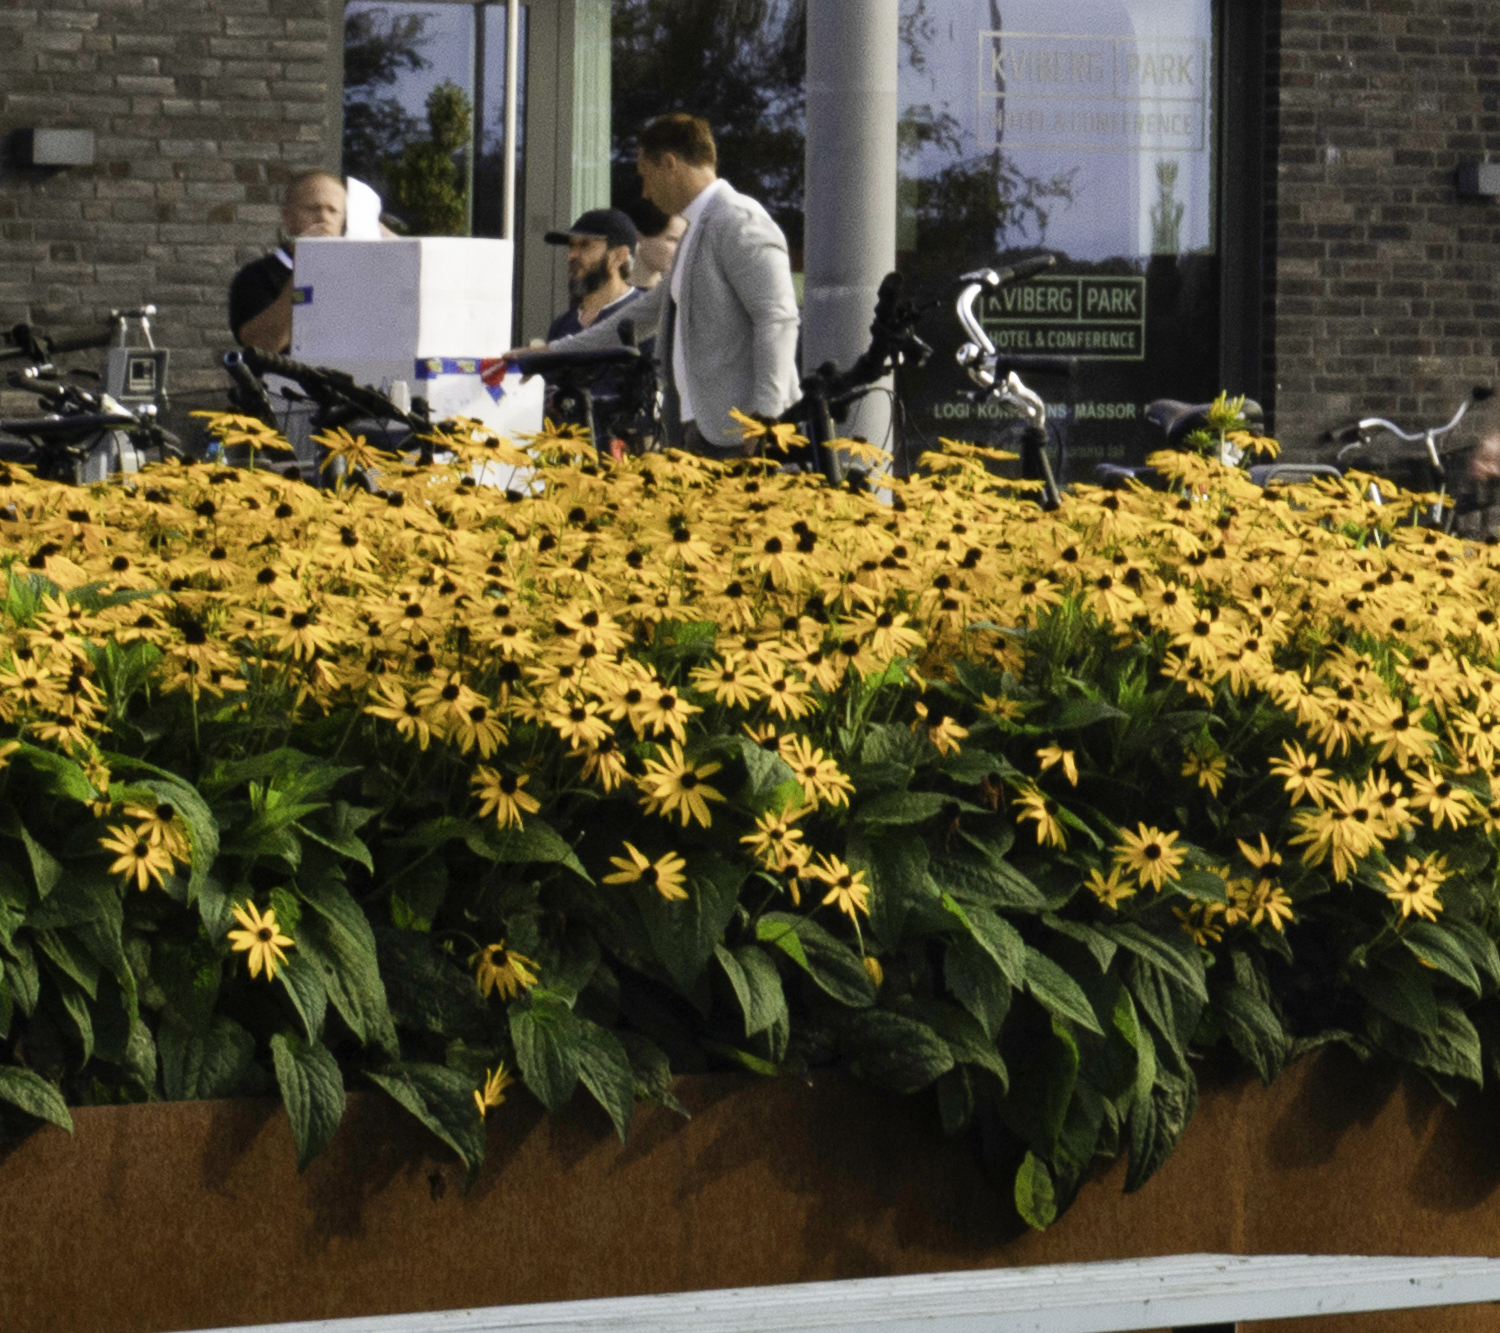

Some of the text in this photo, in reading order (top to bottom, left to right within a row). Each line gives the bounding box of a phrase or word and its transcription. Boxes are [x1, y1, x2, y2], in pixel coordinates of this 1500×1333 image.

[1126, 52, 1194, 85] PARK
[989, 287, 1137, 314] KVIBERG PARK
[1048, 332, 1136, 349] CONFERENCE
[934, 403, 969, 419] LOGI
